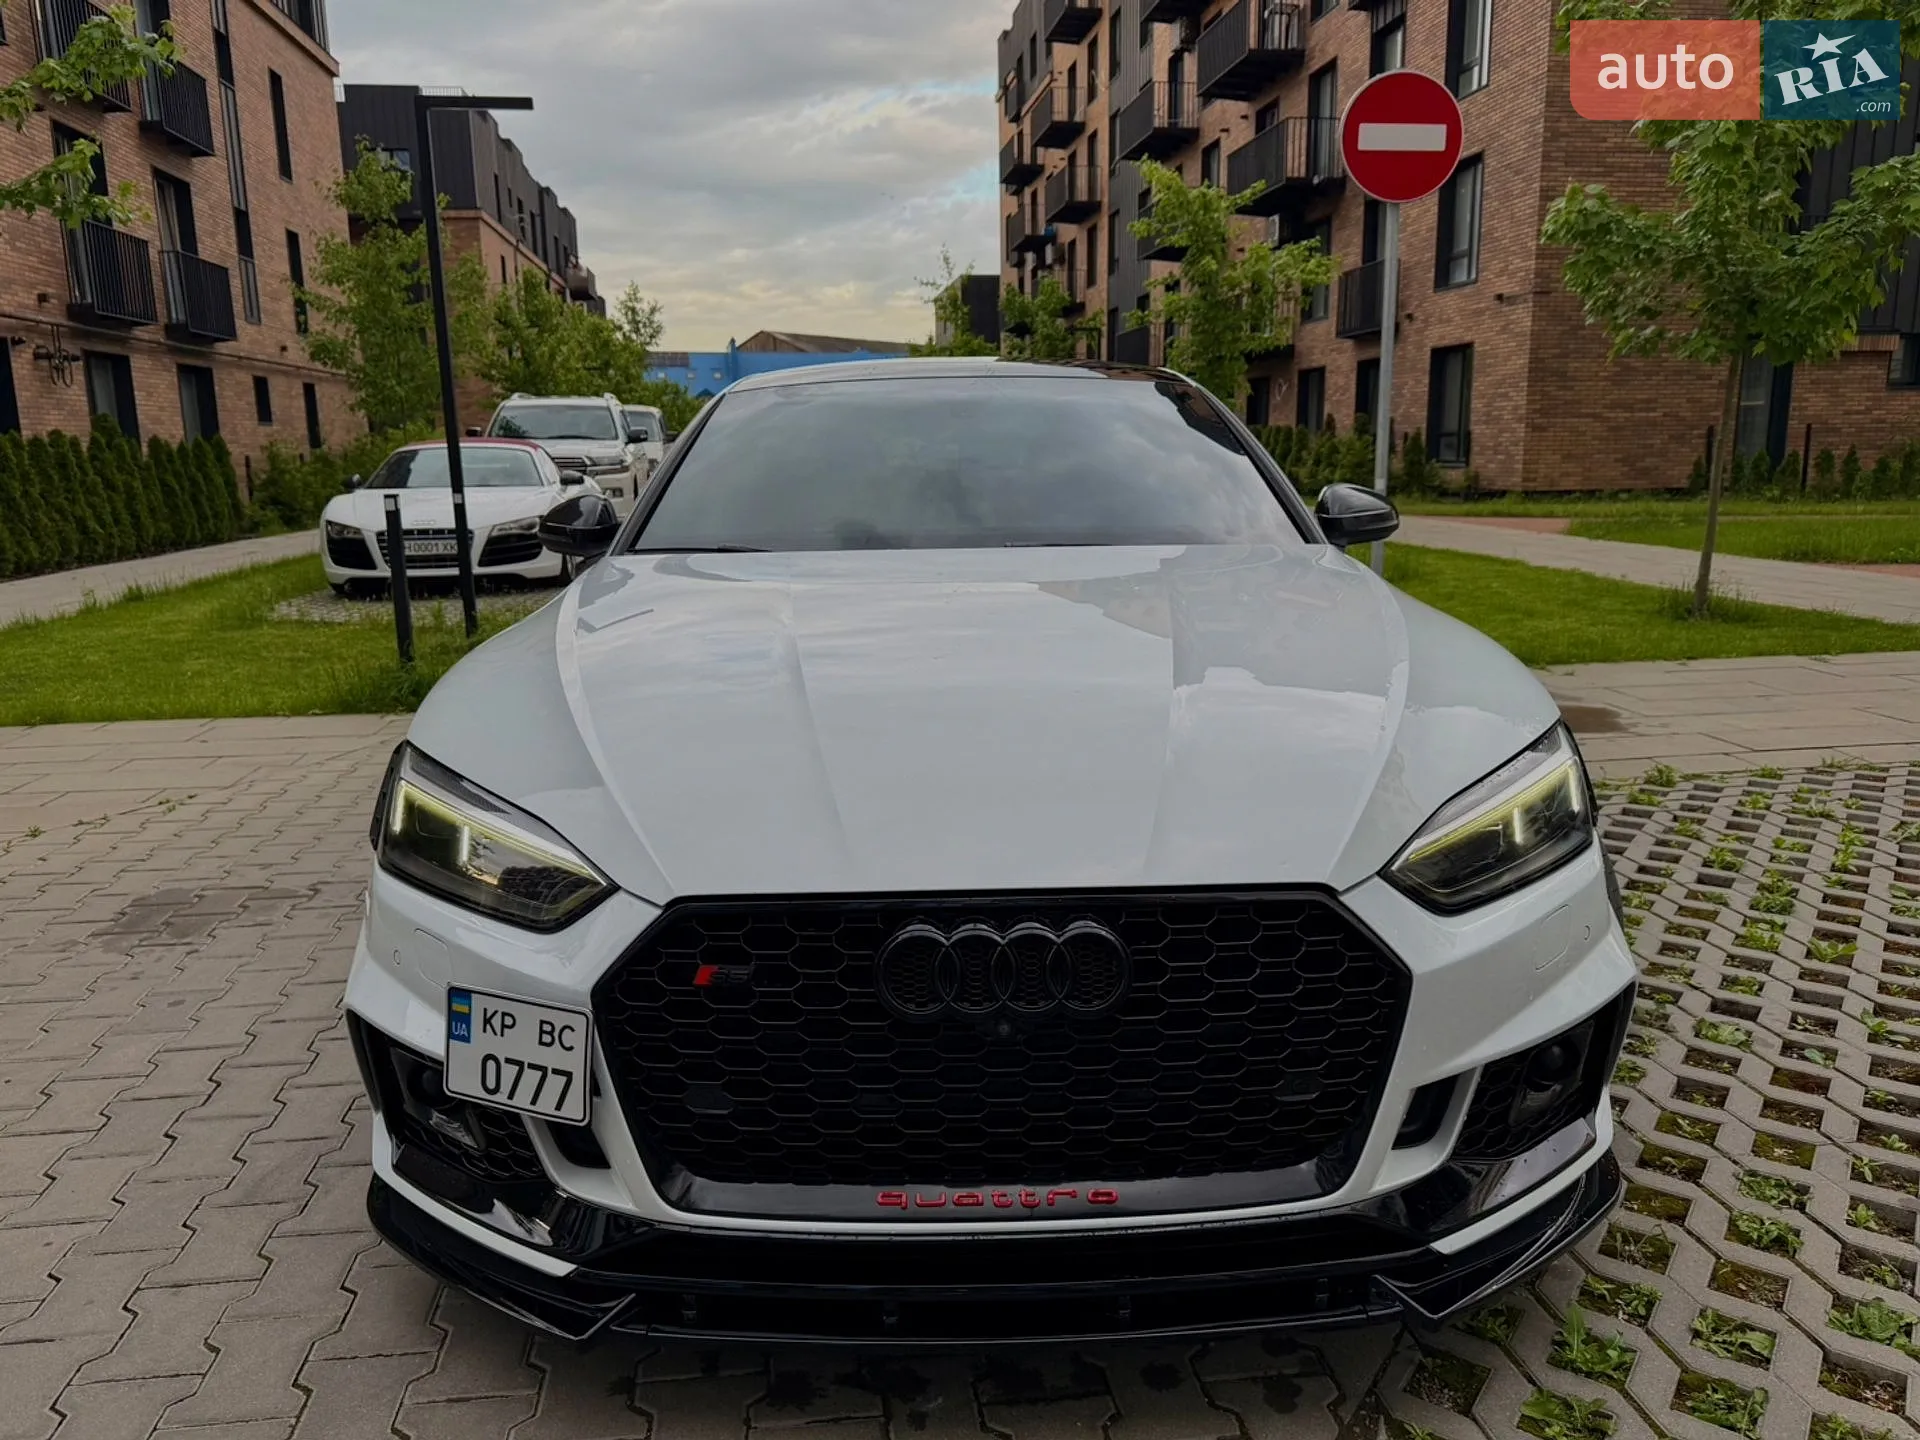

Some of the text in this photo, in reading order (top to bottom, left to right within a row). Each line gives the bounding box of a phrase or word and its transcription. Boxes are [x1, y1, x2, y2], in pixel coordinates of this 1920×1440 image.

[452, 1021, 468, 1037] UA
[482, 1007, 576, 1052] KP BC
[480, 1053, 573, 1112] 0777
[876, 1188, 1119, 1210] quattro
